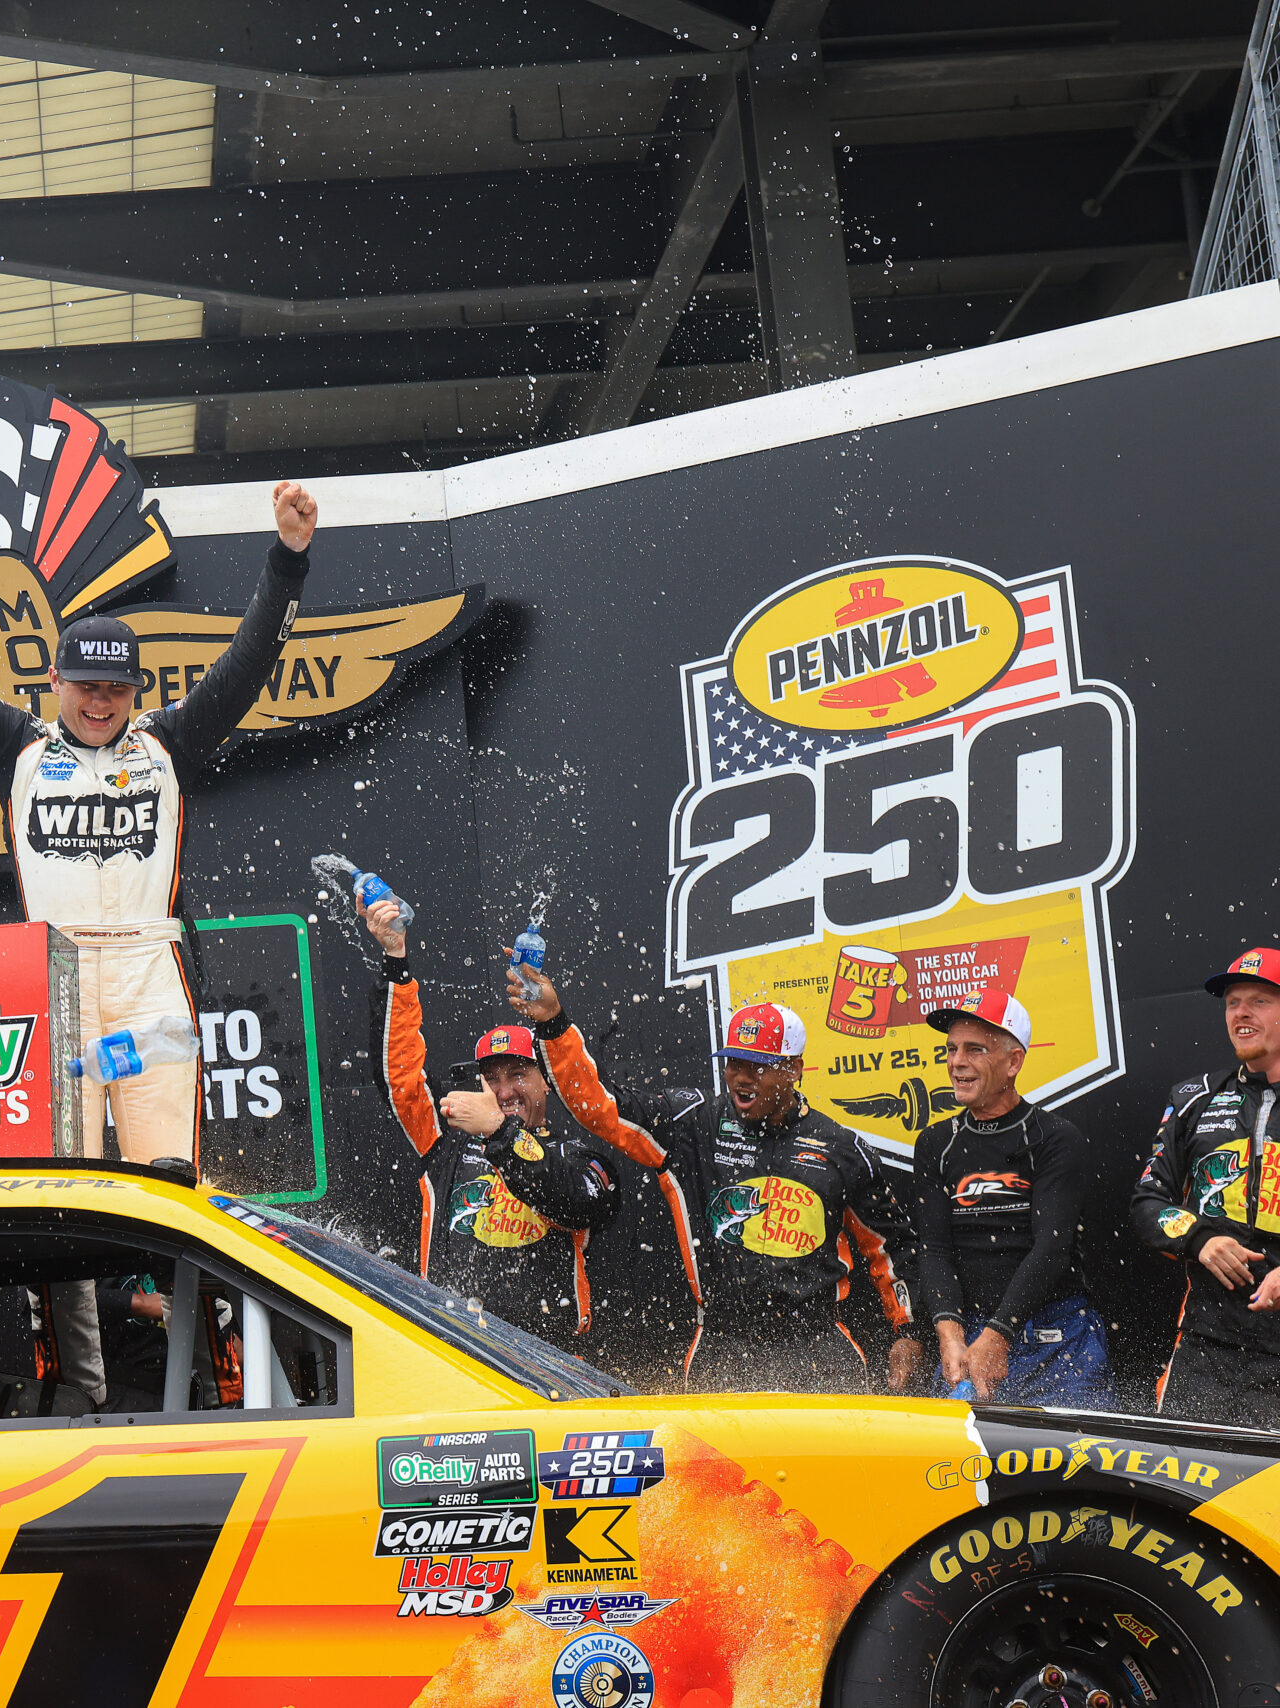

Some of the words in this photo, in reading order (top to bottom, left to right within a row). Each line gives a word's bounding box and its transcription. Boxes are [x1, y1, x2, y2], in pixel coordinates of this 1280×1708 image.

[79, 640, 130, 657] WILDE
[769, 594, 977, 702] PENNZOIL
[133, 655, 343, 710] PEEWAY
[37, 800, 154, 836] WILDE
[48, 836, 98, 848] PROTEIN
[103, 834, 144, 848] SNACKS
[686, 701, 1113, 962] 250
[915, 956, 940, 970] THE
[944, 951, 977, 967] STAY
[773, 976, 829, 990] PRESENTED
[837, 957, 890, 988] TAKE
[917, 972, 931, 985] IN
[933, 967, 972, 983] YOUR
[973, 964, 999, 979] CAR
[817, 985, 829, 995] BY
[918, 986, 932, 1001] 10
[841, 985, 876, 1021] 5
[920, 1000, 937, 1016] OIL
[199, 1009, 262, 1063] TO
[829, 1017, 844, 1032] OIL
[846, 1023, 881, 1038] CHANGE
[828, 1050, 885, 1075] JULY
[891, 1046, 928, 1071] 25,
[761, 1176, 816, 1207] Bass
[951, 1181, 1022, 1200] JR
[489, 1195, 523, 1215] Pro
[762, 1199, 801, 1225] Pro
[952, 1201, 1031, 1213] MOTORSPORTS
[485, 1211, 544, 1241] Shops
[758, 1221, 819, 1252] Shops
[438, 1432, 488, 1447] NASCAR
[393, 1454, 476, 1484] O'Reilly
[484, 1452, 521, 1468] AUTO
[569, 1450, 635, 1477] 250
[480, 1467, 526, 1482] PARTS
[438, 1493, 479, 1506] SERIES
[381, 1514, 531, 1548] COMETIC
[391, 1545, 449, 1554] GASKET
[400, 1556, 511, 1594] Holley
[547, 1566, 638, 1583] KENNAMETAL
[397, 1590, 494, 1616] MSD
[545, 1597, 593, 1613] FIVE
[599, 1595, 645, 1610] STAR
[546, 1614, 582, 1623] RaceCar
[606, 1611, 638, 1620] Bodies
[1121, 1615, 1152, 1641] AERO
[563, 1638, 641, 1669] CHAMPION
[560, 1683, 568, 1691] 19
[637, 1681, 647, 1690] 37
